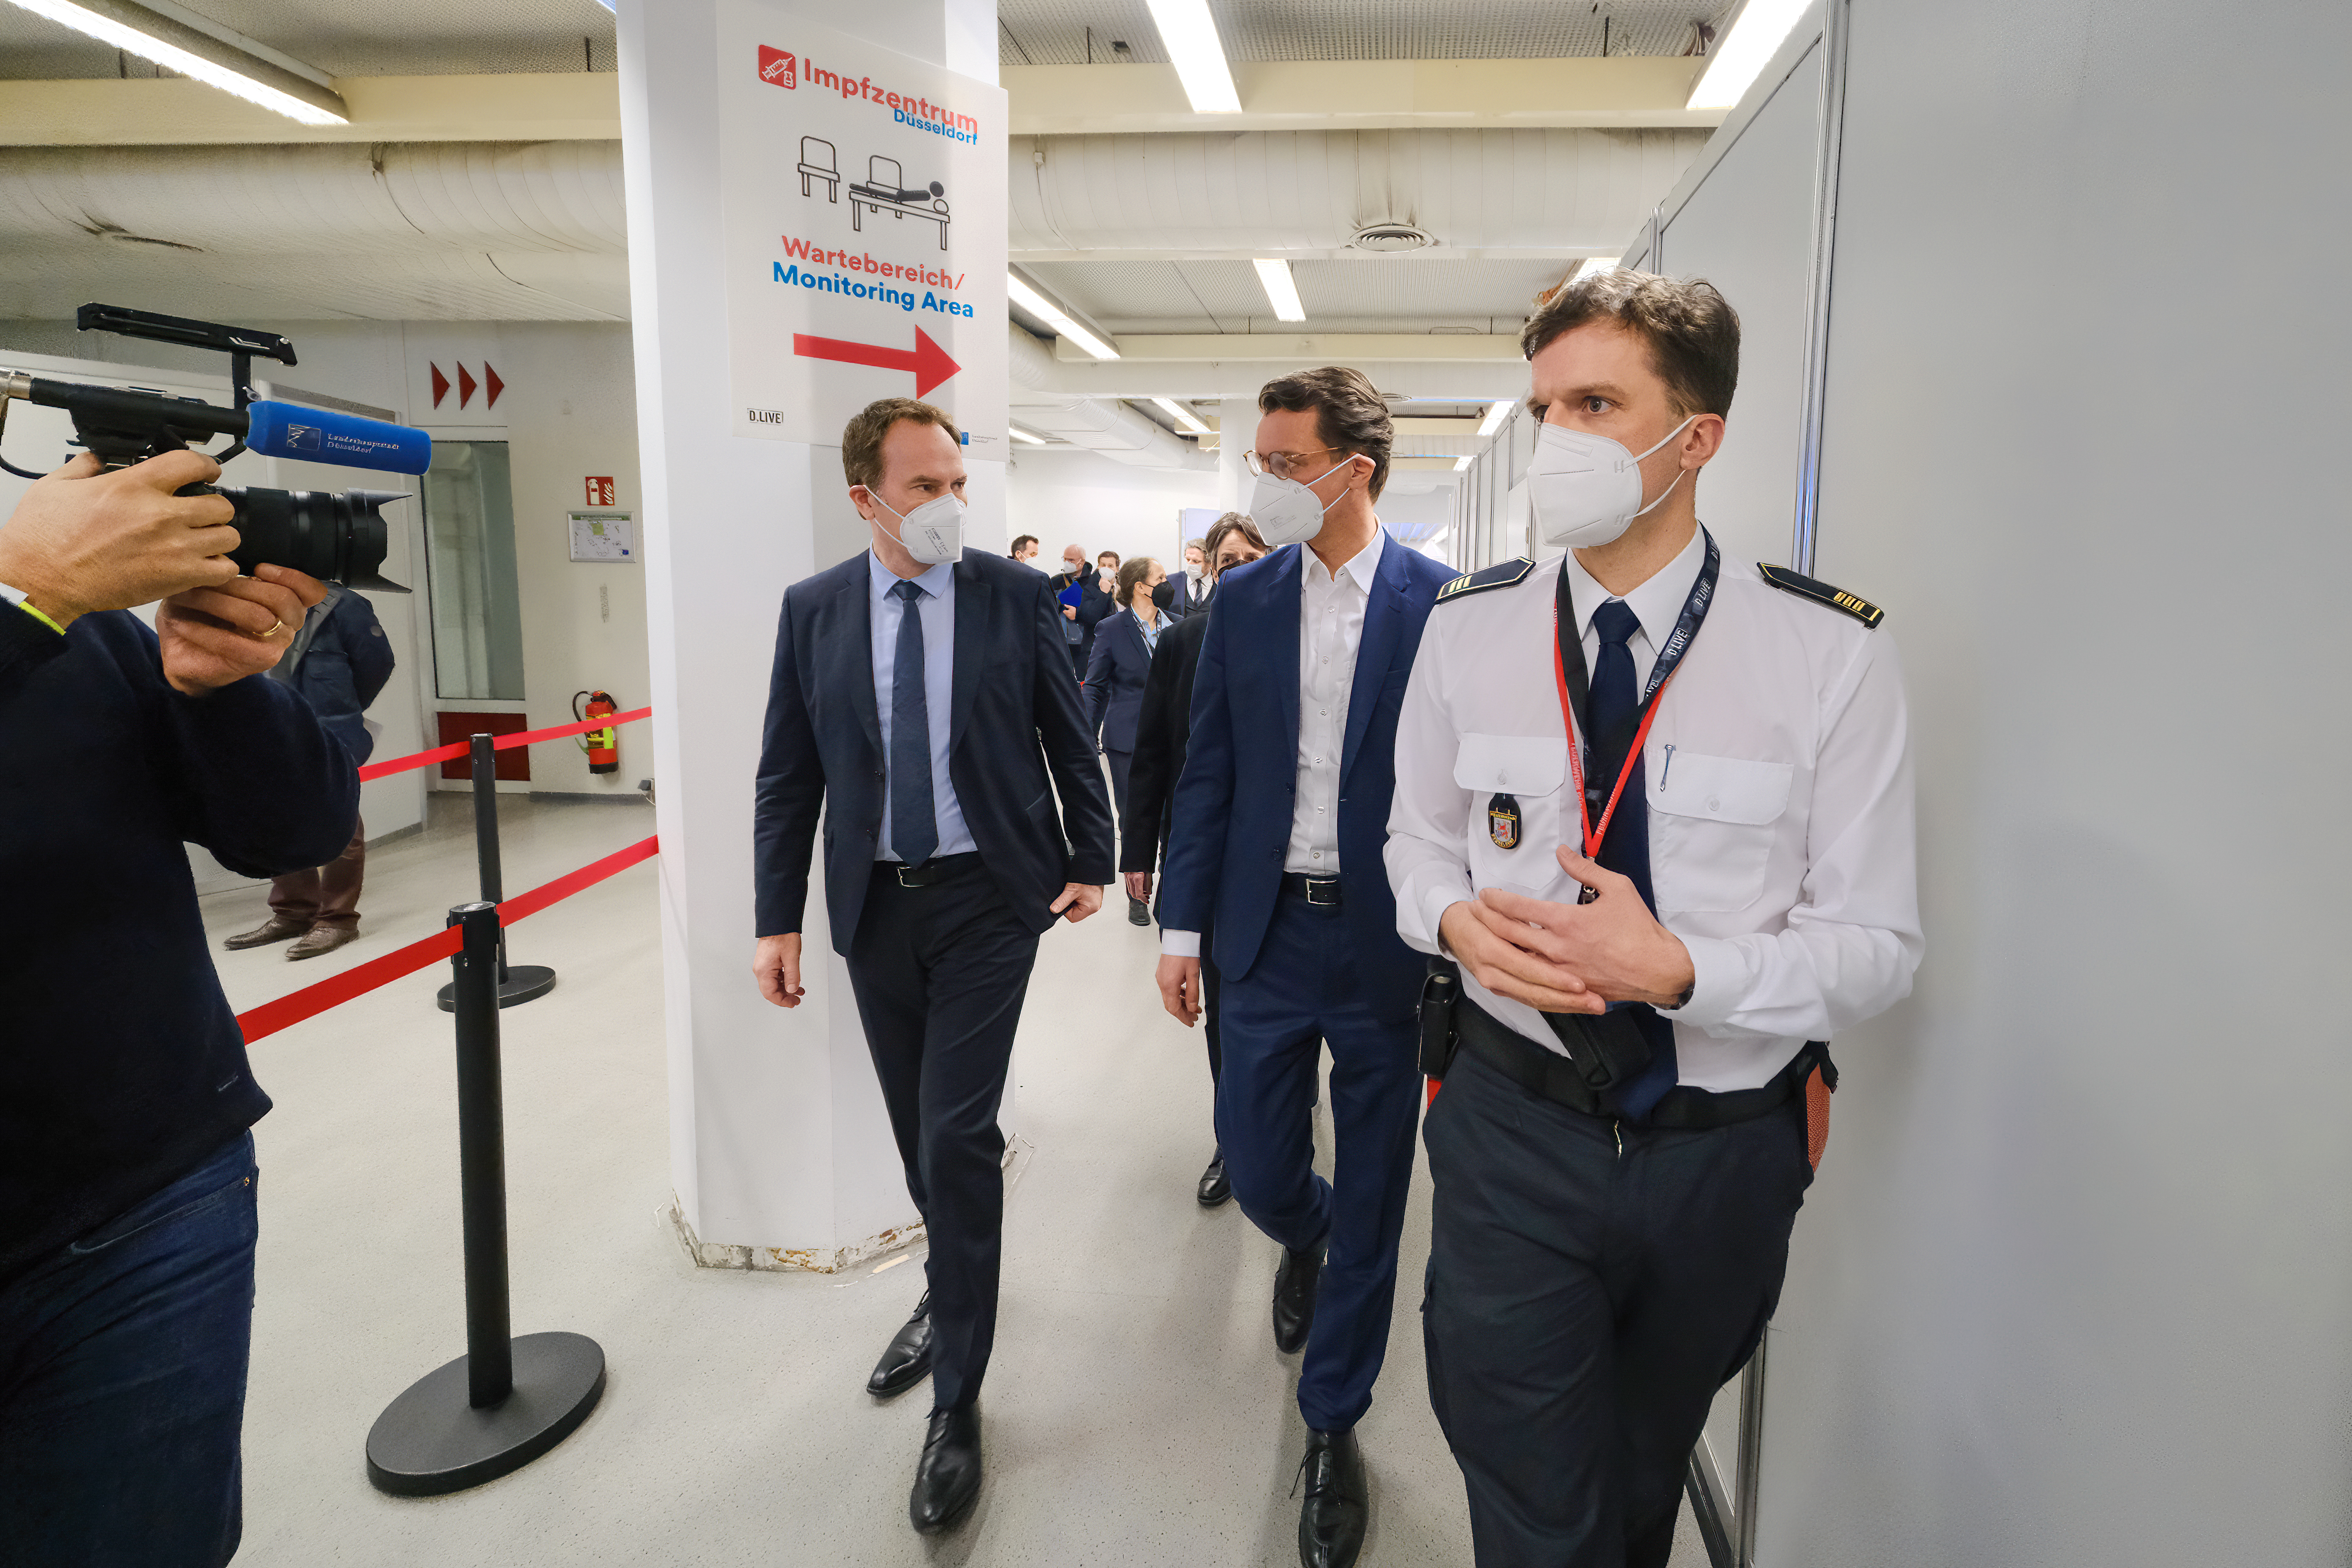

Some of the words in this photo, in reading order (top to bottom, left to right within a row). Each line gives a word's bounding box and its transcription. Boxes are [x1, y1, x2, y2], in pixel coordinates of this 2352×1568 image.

[805, 58, 977, 134] Impfzentrum
[894, 109, 977, 145] Düsseldorf
[773, 261, 915, 312] Monitoring
[921, 291, 974, 318] Area
[782, 235, 965, 290] Wartebereich/
[749, 410, 781, 424] D.LIVE
